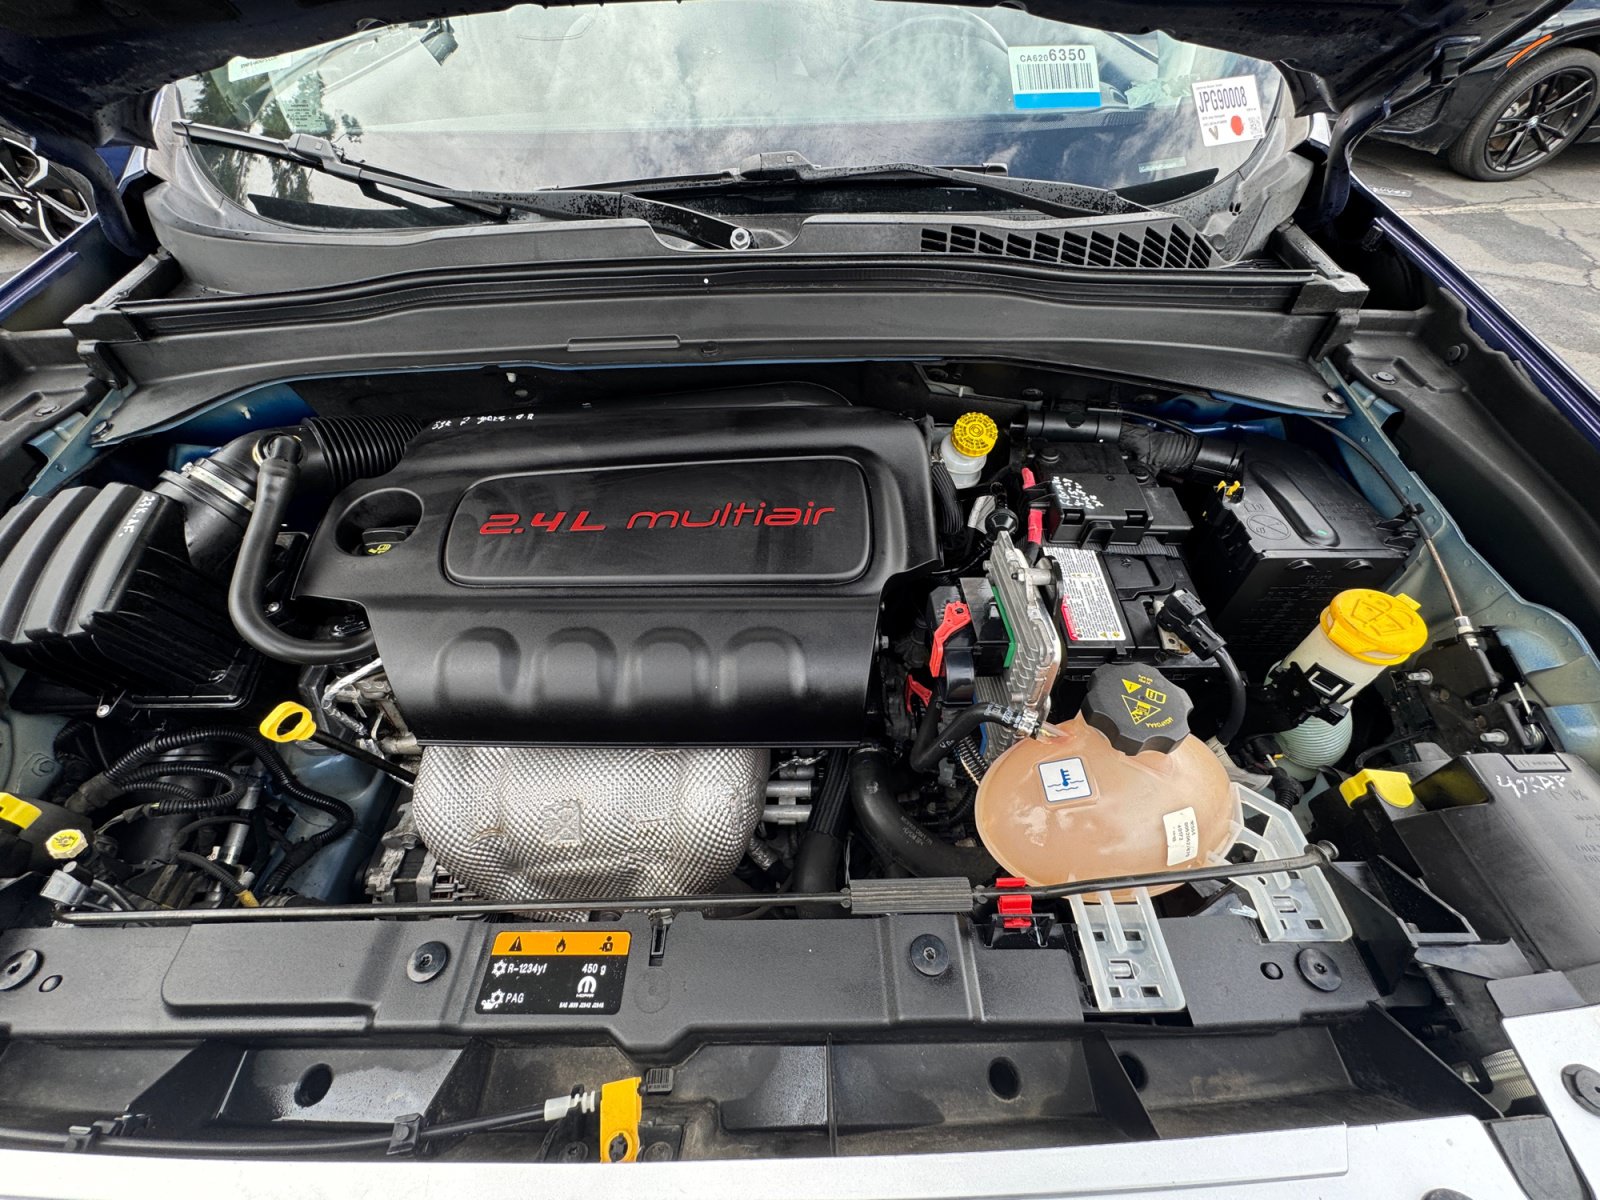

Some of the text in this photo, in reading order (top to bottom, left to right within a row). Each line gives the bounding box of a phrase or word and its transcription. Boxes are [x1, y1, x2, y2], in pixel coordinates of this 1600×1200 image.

[1019, 48, 1086, 62] CA6206350
[1198, 86, 1247, 112] JPG90008
[479, 501, 836, 536] 2.4L multiair
[507, 963, 607, 976] R-1234yf 450 g
[505, 992, 524, 1003] PAG
